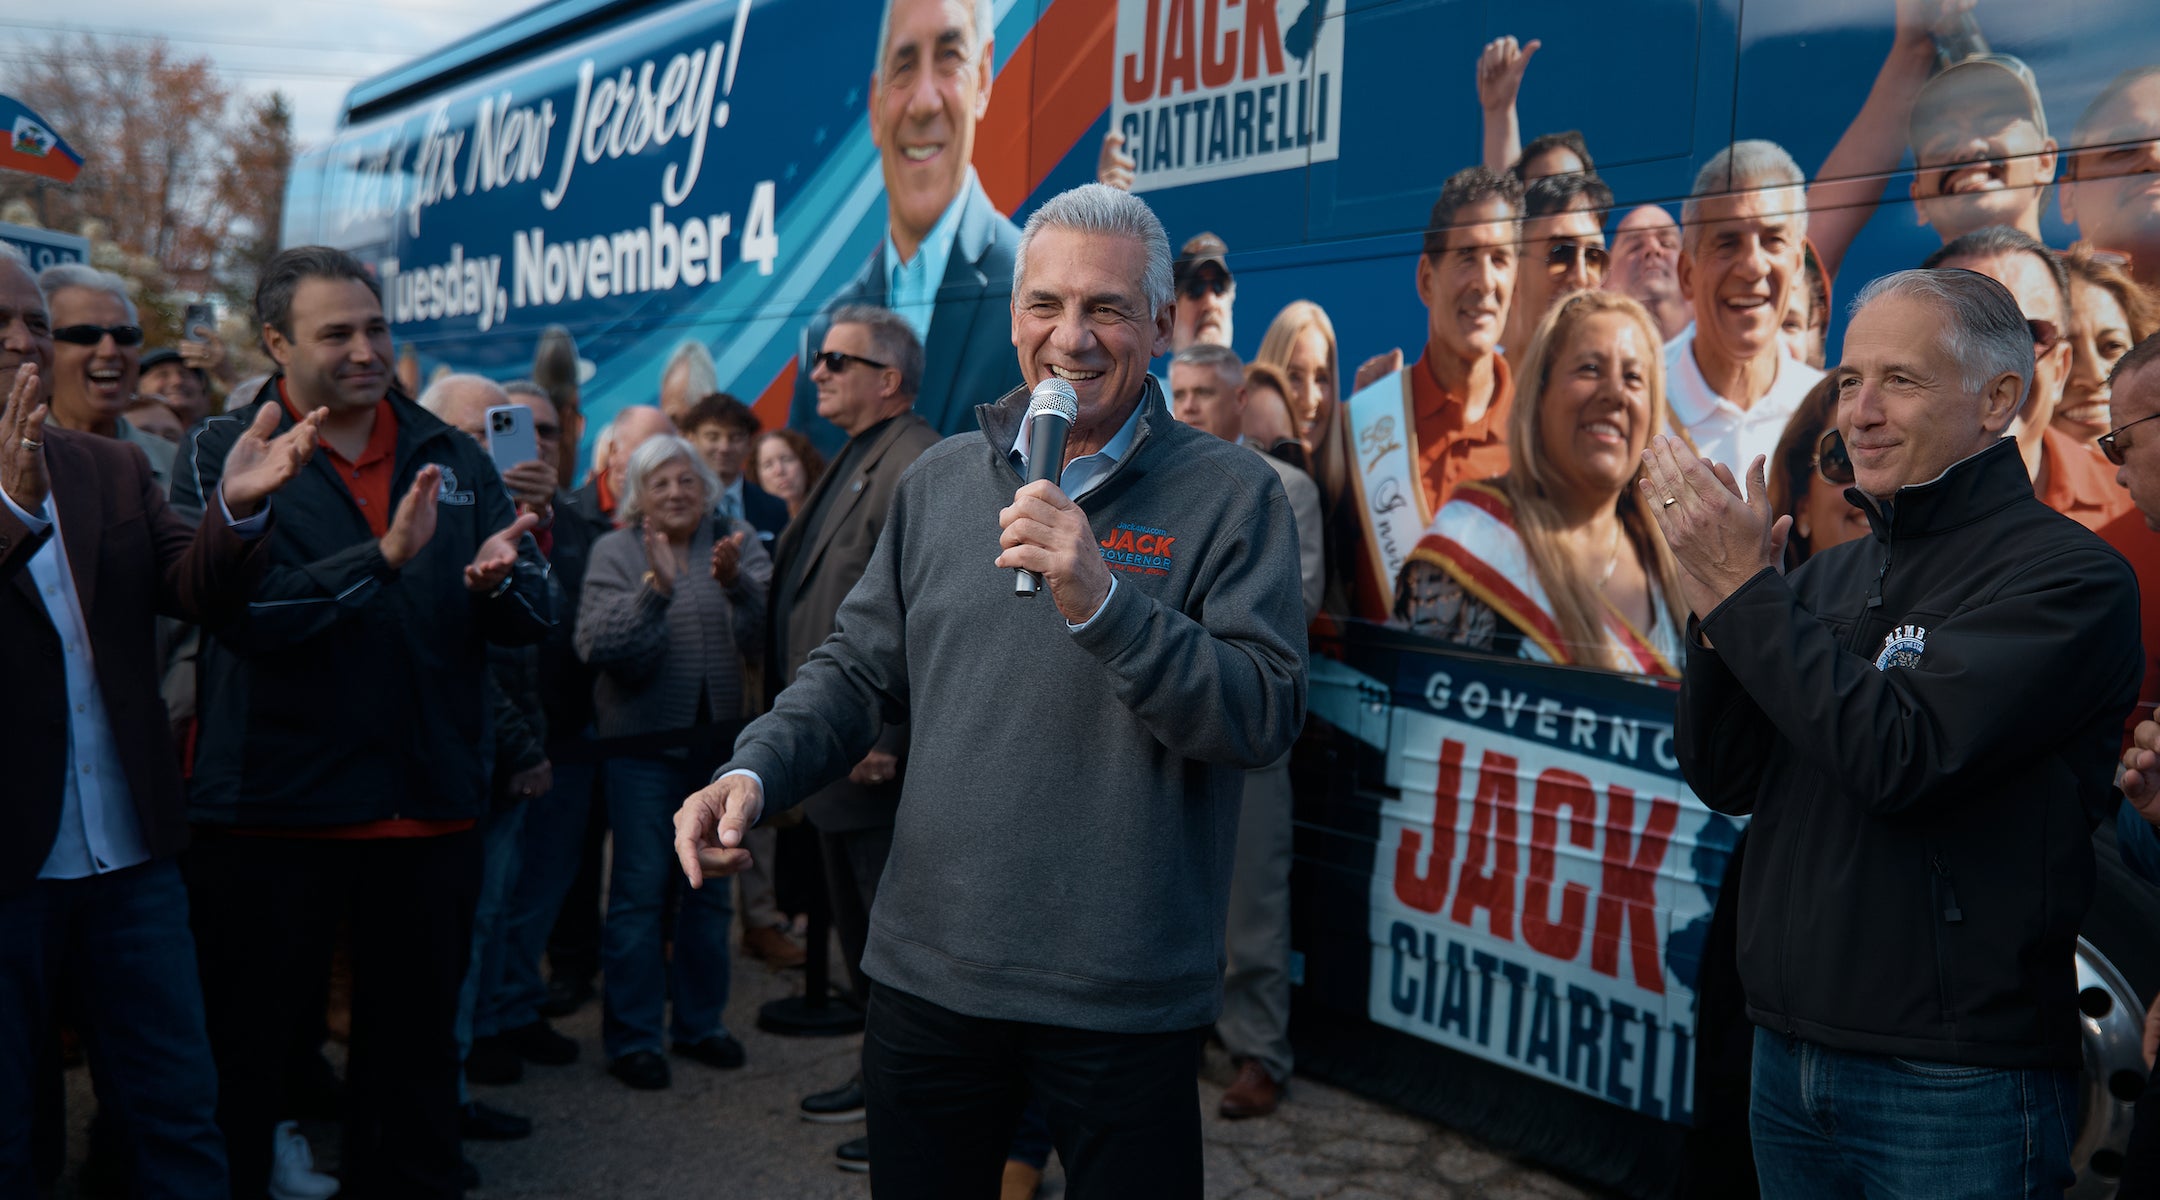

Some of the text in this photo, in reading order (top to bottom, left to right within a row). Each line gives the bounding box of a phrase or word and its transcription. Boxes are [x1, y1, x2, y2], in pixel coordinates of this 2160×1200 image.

[463, 90, 556, 195] New
[541, 0, 753, 210] Jersey!
[1122, 0, 1286, 106] JACK
[1121, 72, 1330, 176] CIATTARELLI
[381, 180, 779, 332] Tuesday, November 4
[1099, 548, 1171, 569] GOVERNOR
[1101, 528, 1176, 558] JACK
[1885, 625, 1926, 646] MEMB
[1393, 738, 1680, 996] JACK
